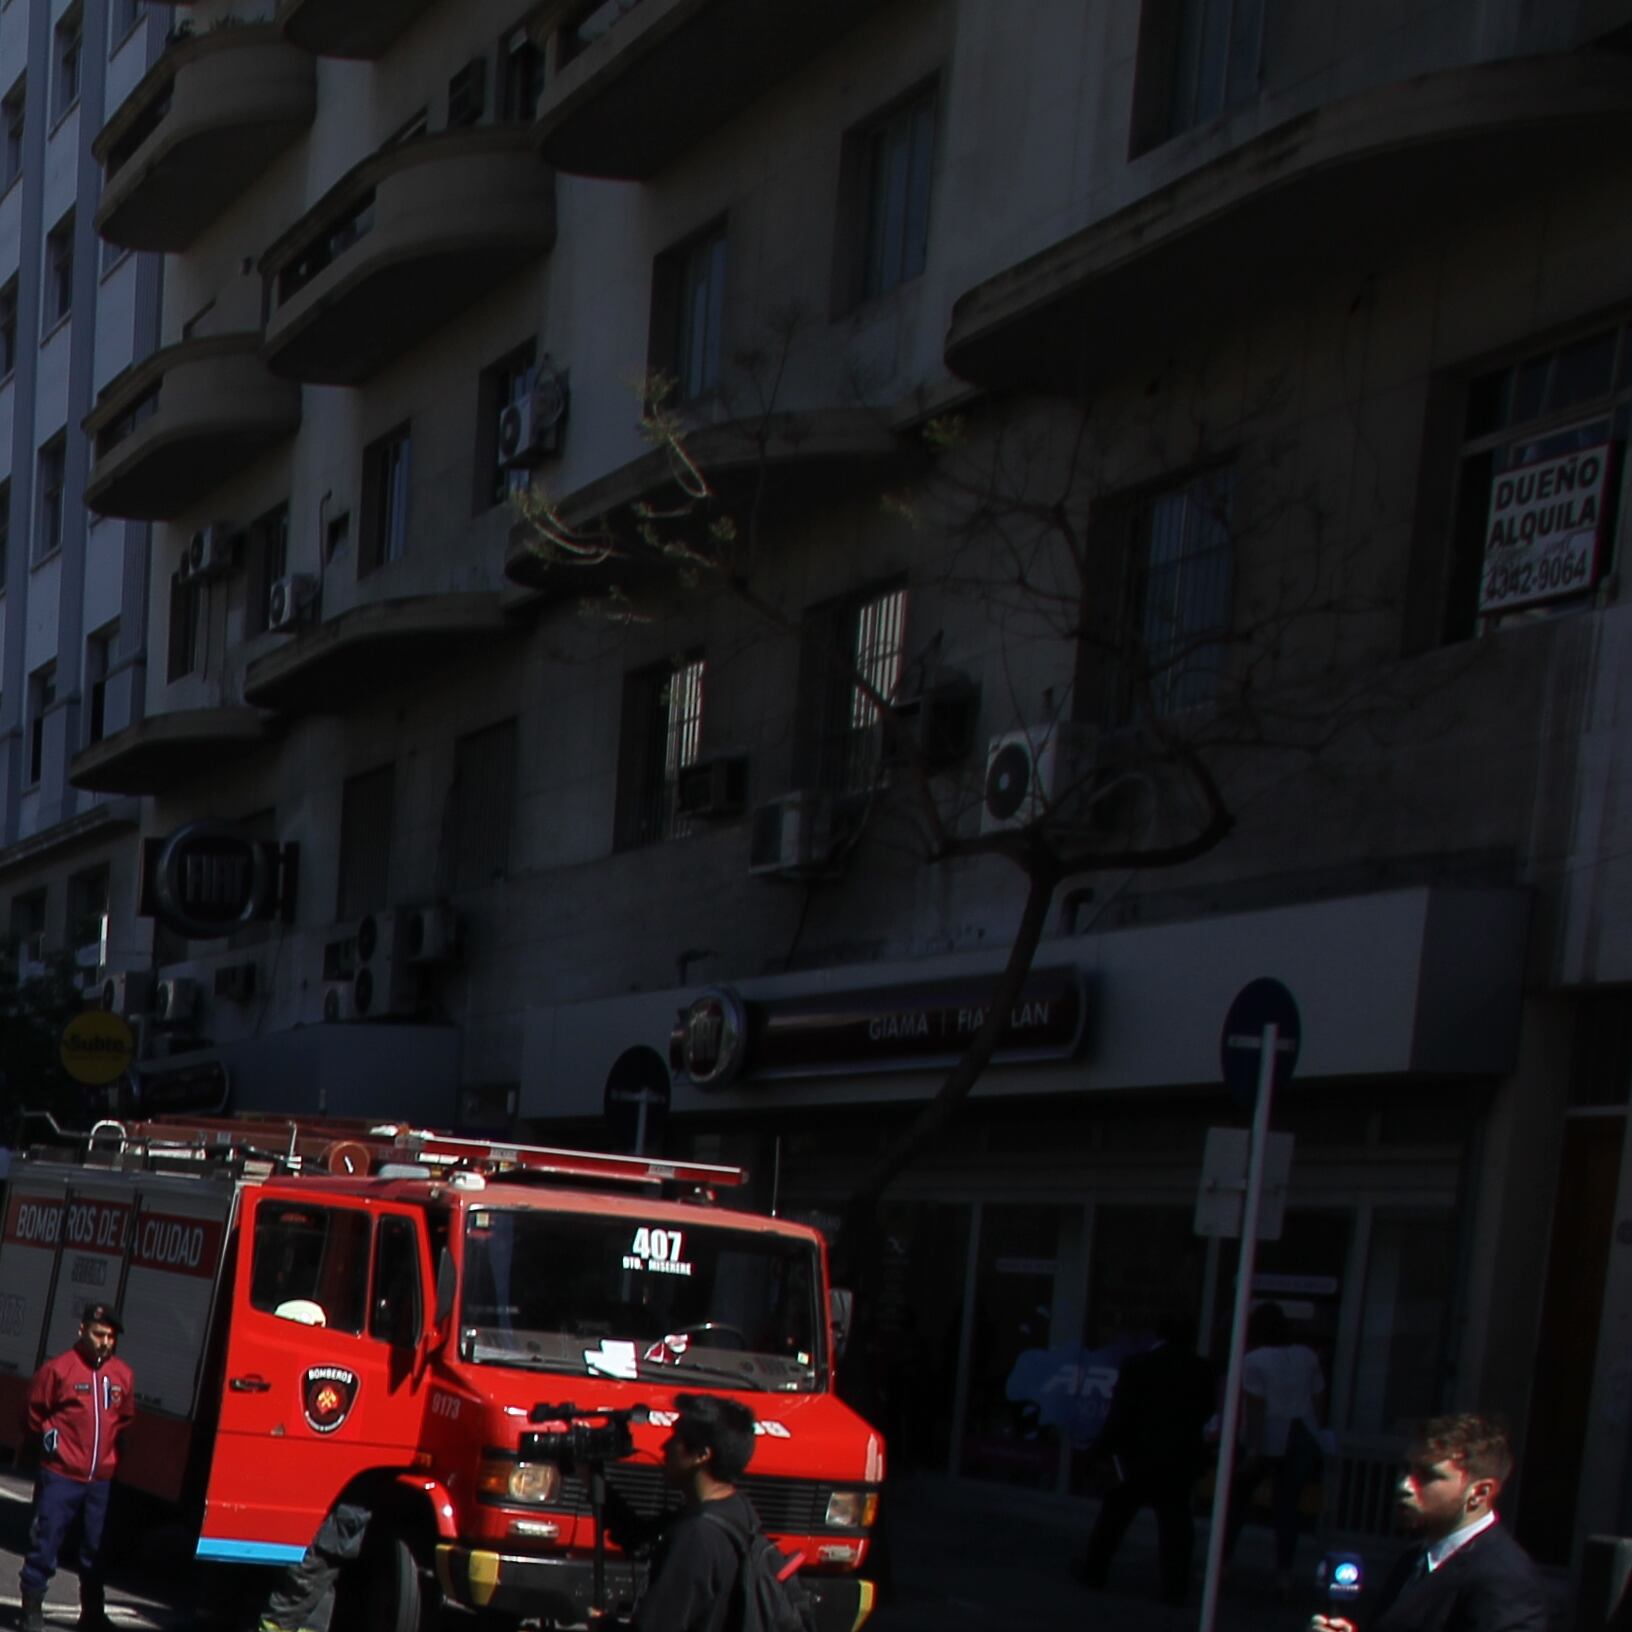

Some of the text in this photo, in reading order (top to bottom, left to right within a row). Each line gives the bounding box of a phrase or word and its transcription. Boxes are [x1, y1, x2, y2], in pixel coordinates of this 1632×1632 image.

[1495, 456, 1600, 512] DUEÑO
[1487, 496, 1596, 549] ALQUILA
[186, 854, 248, 903] FIAT
[868, 1002, 1050, 1041] GIAMA FIA LAN
[15, 1203, 96, 1244] BOMBEROS
[96, 1209, 122, 1247] DE
[142, 1220, 204, 1268] CIUDAD
[632, 1227, 682, 1262] 407
[308, 1367, 353, 1385] BOMBEROS
